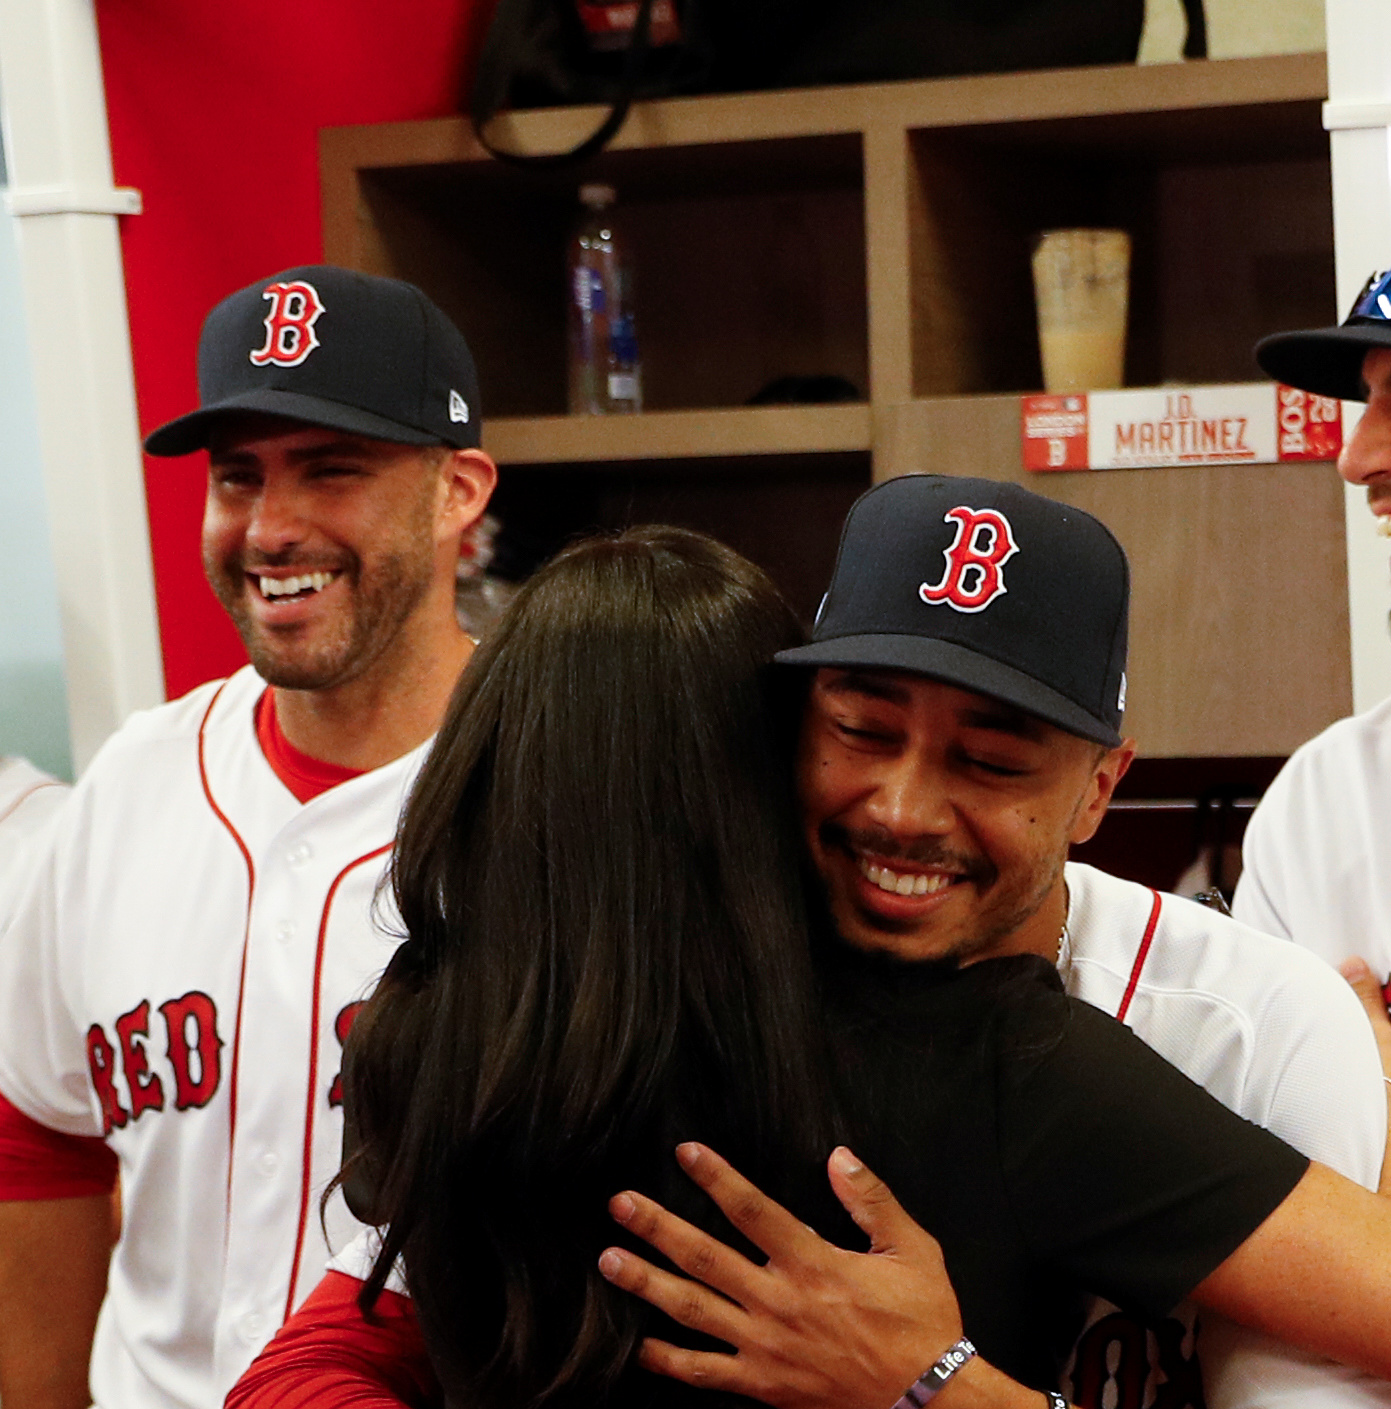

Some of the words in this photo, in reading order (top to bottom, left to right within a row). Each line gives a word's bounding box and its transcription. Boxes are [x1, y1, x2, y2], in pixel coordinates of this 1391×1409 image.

[249, 280, 327, 368] B
[1115, 417, 1250, 454] MARTINEZ
[918, 505, 1020, 613] B
[933, 1349, 965, 1380] Life
